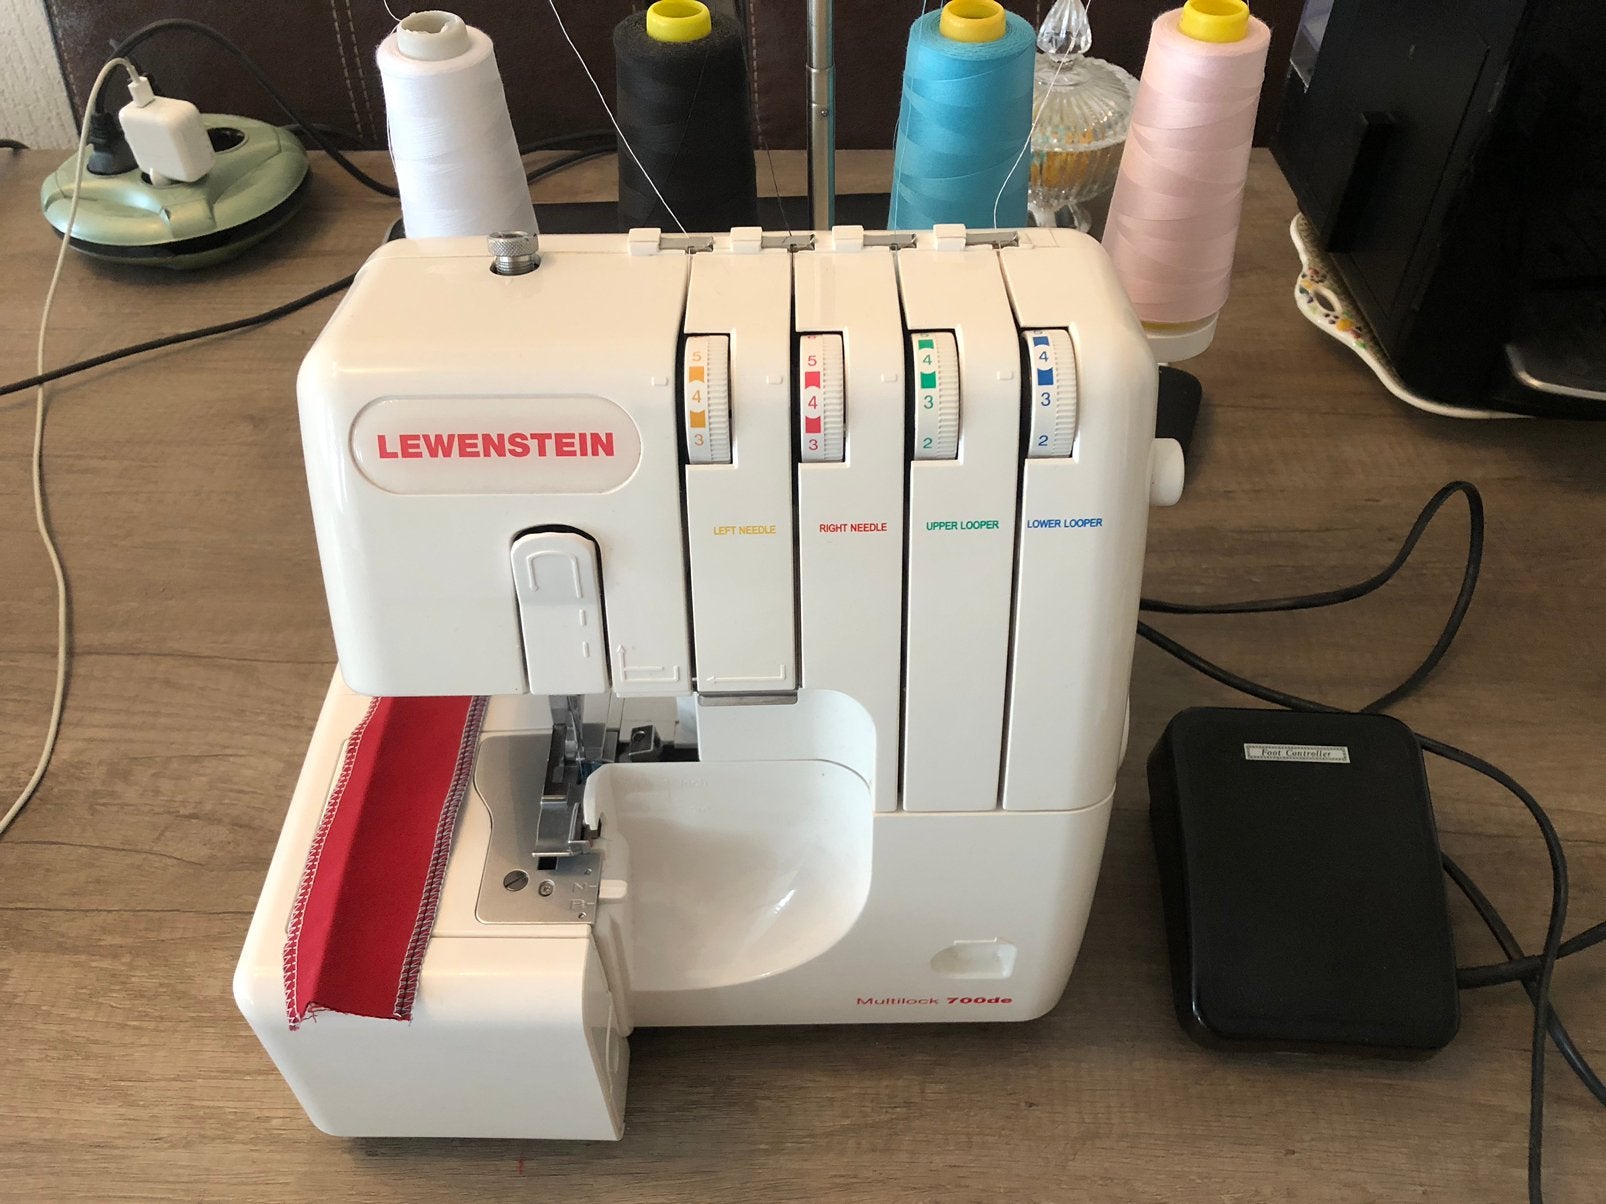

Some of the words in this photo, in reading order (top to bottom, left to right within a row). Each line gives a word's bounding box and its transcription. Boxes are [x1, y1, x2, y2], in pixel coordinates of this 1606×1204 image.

[691, 351, 702, 362] 5
[807, 355, 818, 367] 5
[922, 354, 933, 366] 4
[1038, 351, 1049, 363] 4
[691, 389, 702, 404] 4
[807, 395, 818, 410] 4
[923, 394, 934, 410] 3
[1040, 392, 1051, 407] 3
[376, 432, 615, 459] LEWENSTEIN
[694, 433, 705, 447] 3
[808, 438, 819, 451] 3
[922, 437, 933, 449] 2
[1038, 434, 1049, 447] 2
[819, 523, 847, 533] RIGHT
[850, 522, 888, 532] NEEDLE
[926, 521, 958, 531] UPPER
[960, 520, 999, 530] LOOPER
[1027, 519, 1061, 529] LOWER
[1063, 518, 1103, 528] LOOPER
[713, 526, 736, 536] LEFT
[738, 525, 777, 535] NEEDLE
[1261, 749, 1281, 757] Foot
[1285, 749, 1331, 758] Controller
[856, 997, 939, 1006] Multilock
[946, 996, 1013, 1005] 700de
